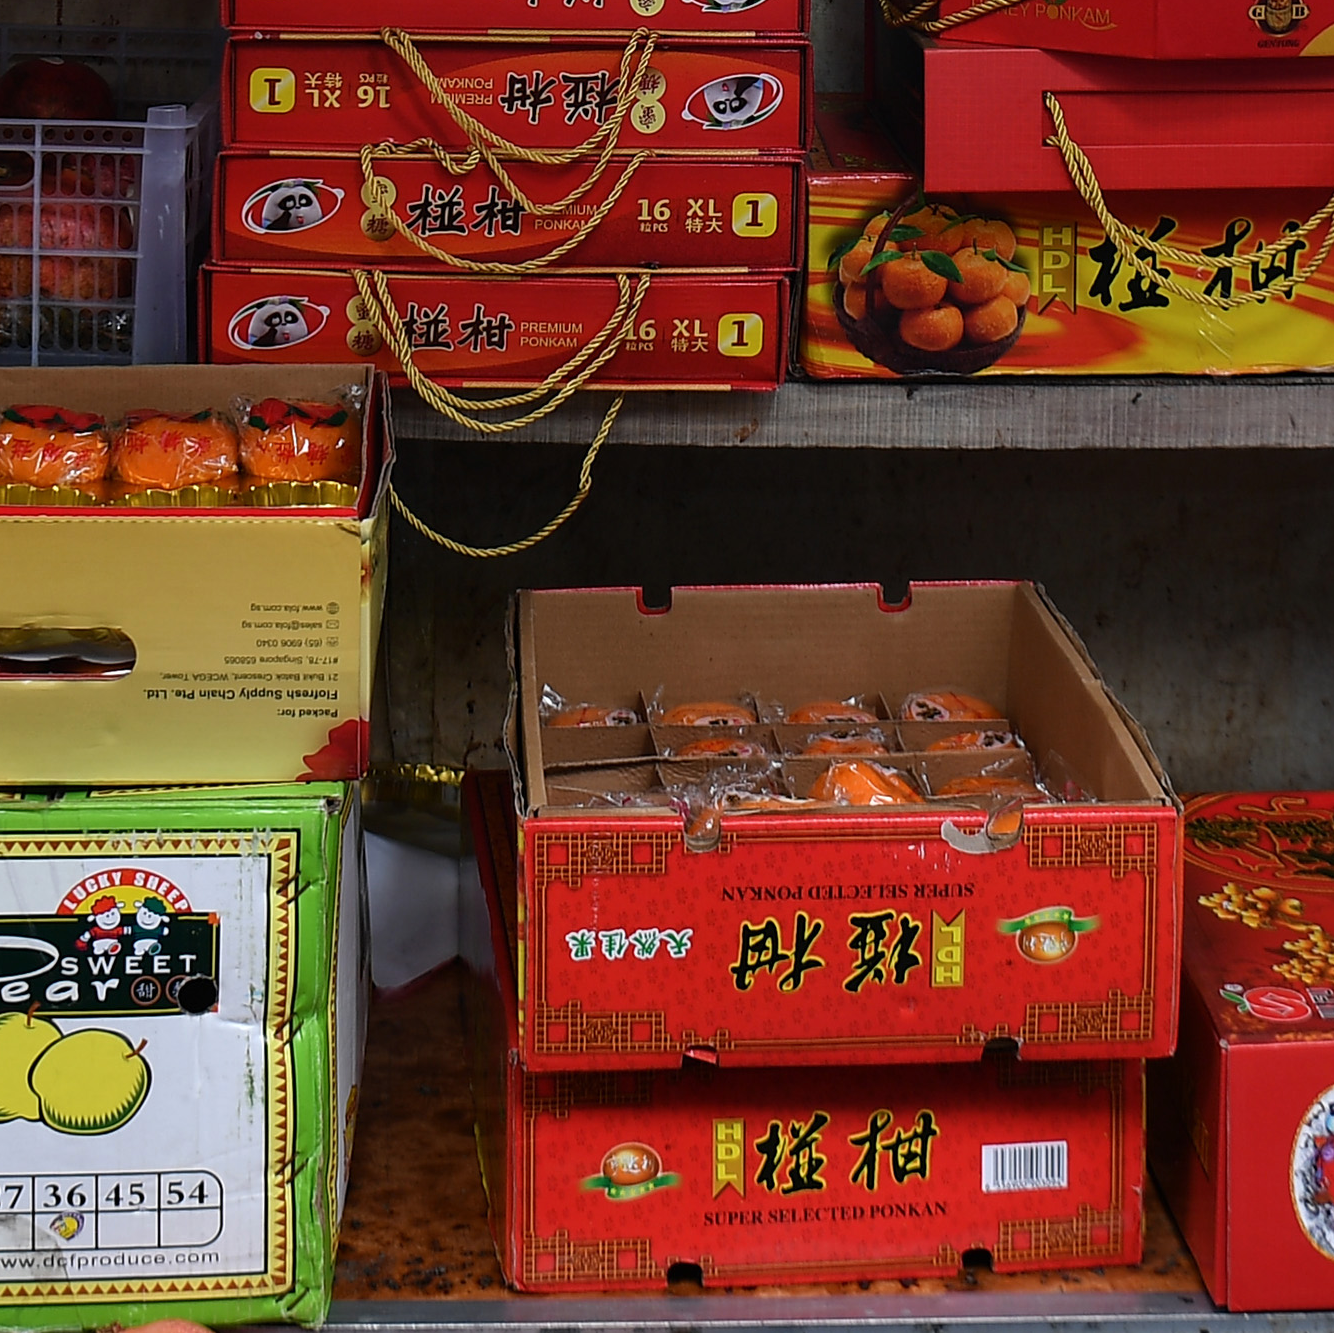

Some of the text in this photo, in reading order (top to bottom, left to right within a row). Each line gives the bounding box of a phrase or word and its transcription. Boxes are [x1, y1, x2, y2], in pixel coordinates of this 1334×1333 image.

[304, 71, 344, 88] 特大
[265, 76, 282, 106] 1
[305, 84, 391, 110] 16 XL
[499, 69, 622, 127] 椪柑
[405, 184, 527, 238] 椪柑
[636, 198, 722, 221] 16 XL
[745, 199, 764, 229] 1
[685, 216, 724, 234] 特大
[1042, 225, 1072, 296] HDL
[402, 301, 515, 352] 椪柑
[519, 322, 583, 334] PREMIUM
[671, 318, 709, 337] XL
[732, 319, 750, 349] 1
[519, 336, 578, 348] PONKAM
[671, 336, 709, 354] 特大
[250, 602, 324, 614] www.fola.com.sg
[241, 619, 323, 631] sales@fola.com.sg
[256, 637, 323, 648] (65) 6906 0340
[223, 655, 257, 665] 658065
[259, 653, 304, 664] Singapore
[192, 672, 229, 682] WCEGA
[231, 671, 273, 682] Crescent,
[276, 672, 301, 682] Batok
[303, 672, 325, 682] Bukit
[328, 672, 339, 682] 21
[142, 686, 338, 700] Flofresh Supply Chain Pte. Ltd.
[276, 707, 338, 718] Packed for:
[63, 870, 190, 913] LUCKY SHEEP
[720, 882, 975, 904] SUPER SELECTED PONKAN
[565, 928, 694, 962] 天然佳果
[729, 910, 923, 994] 椪柑
[933, 921, 964, 987] HDL
[61, 953, 198, 976] SWEET
[714, 1120, 743, 1182] HDL
[753, 1109, 941, 1195] 椪柑
[42, 1182, 88, 1209] 36
[104, 1181, 147, 1208] 45
[166, 1180, 209, 1206] 54
[703, 1200, 949, 1228] SUPER SELECTED PONKAN
